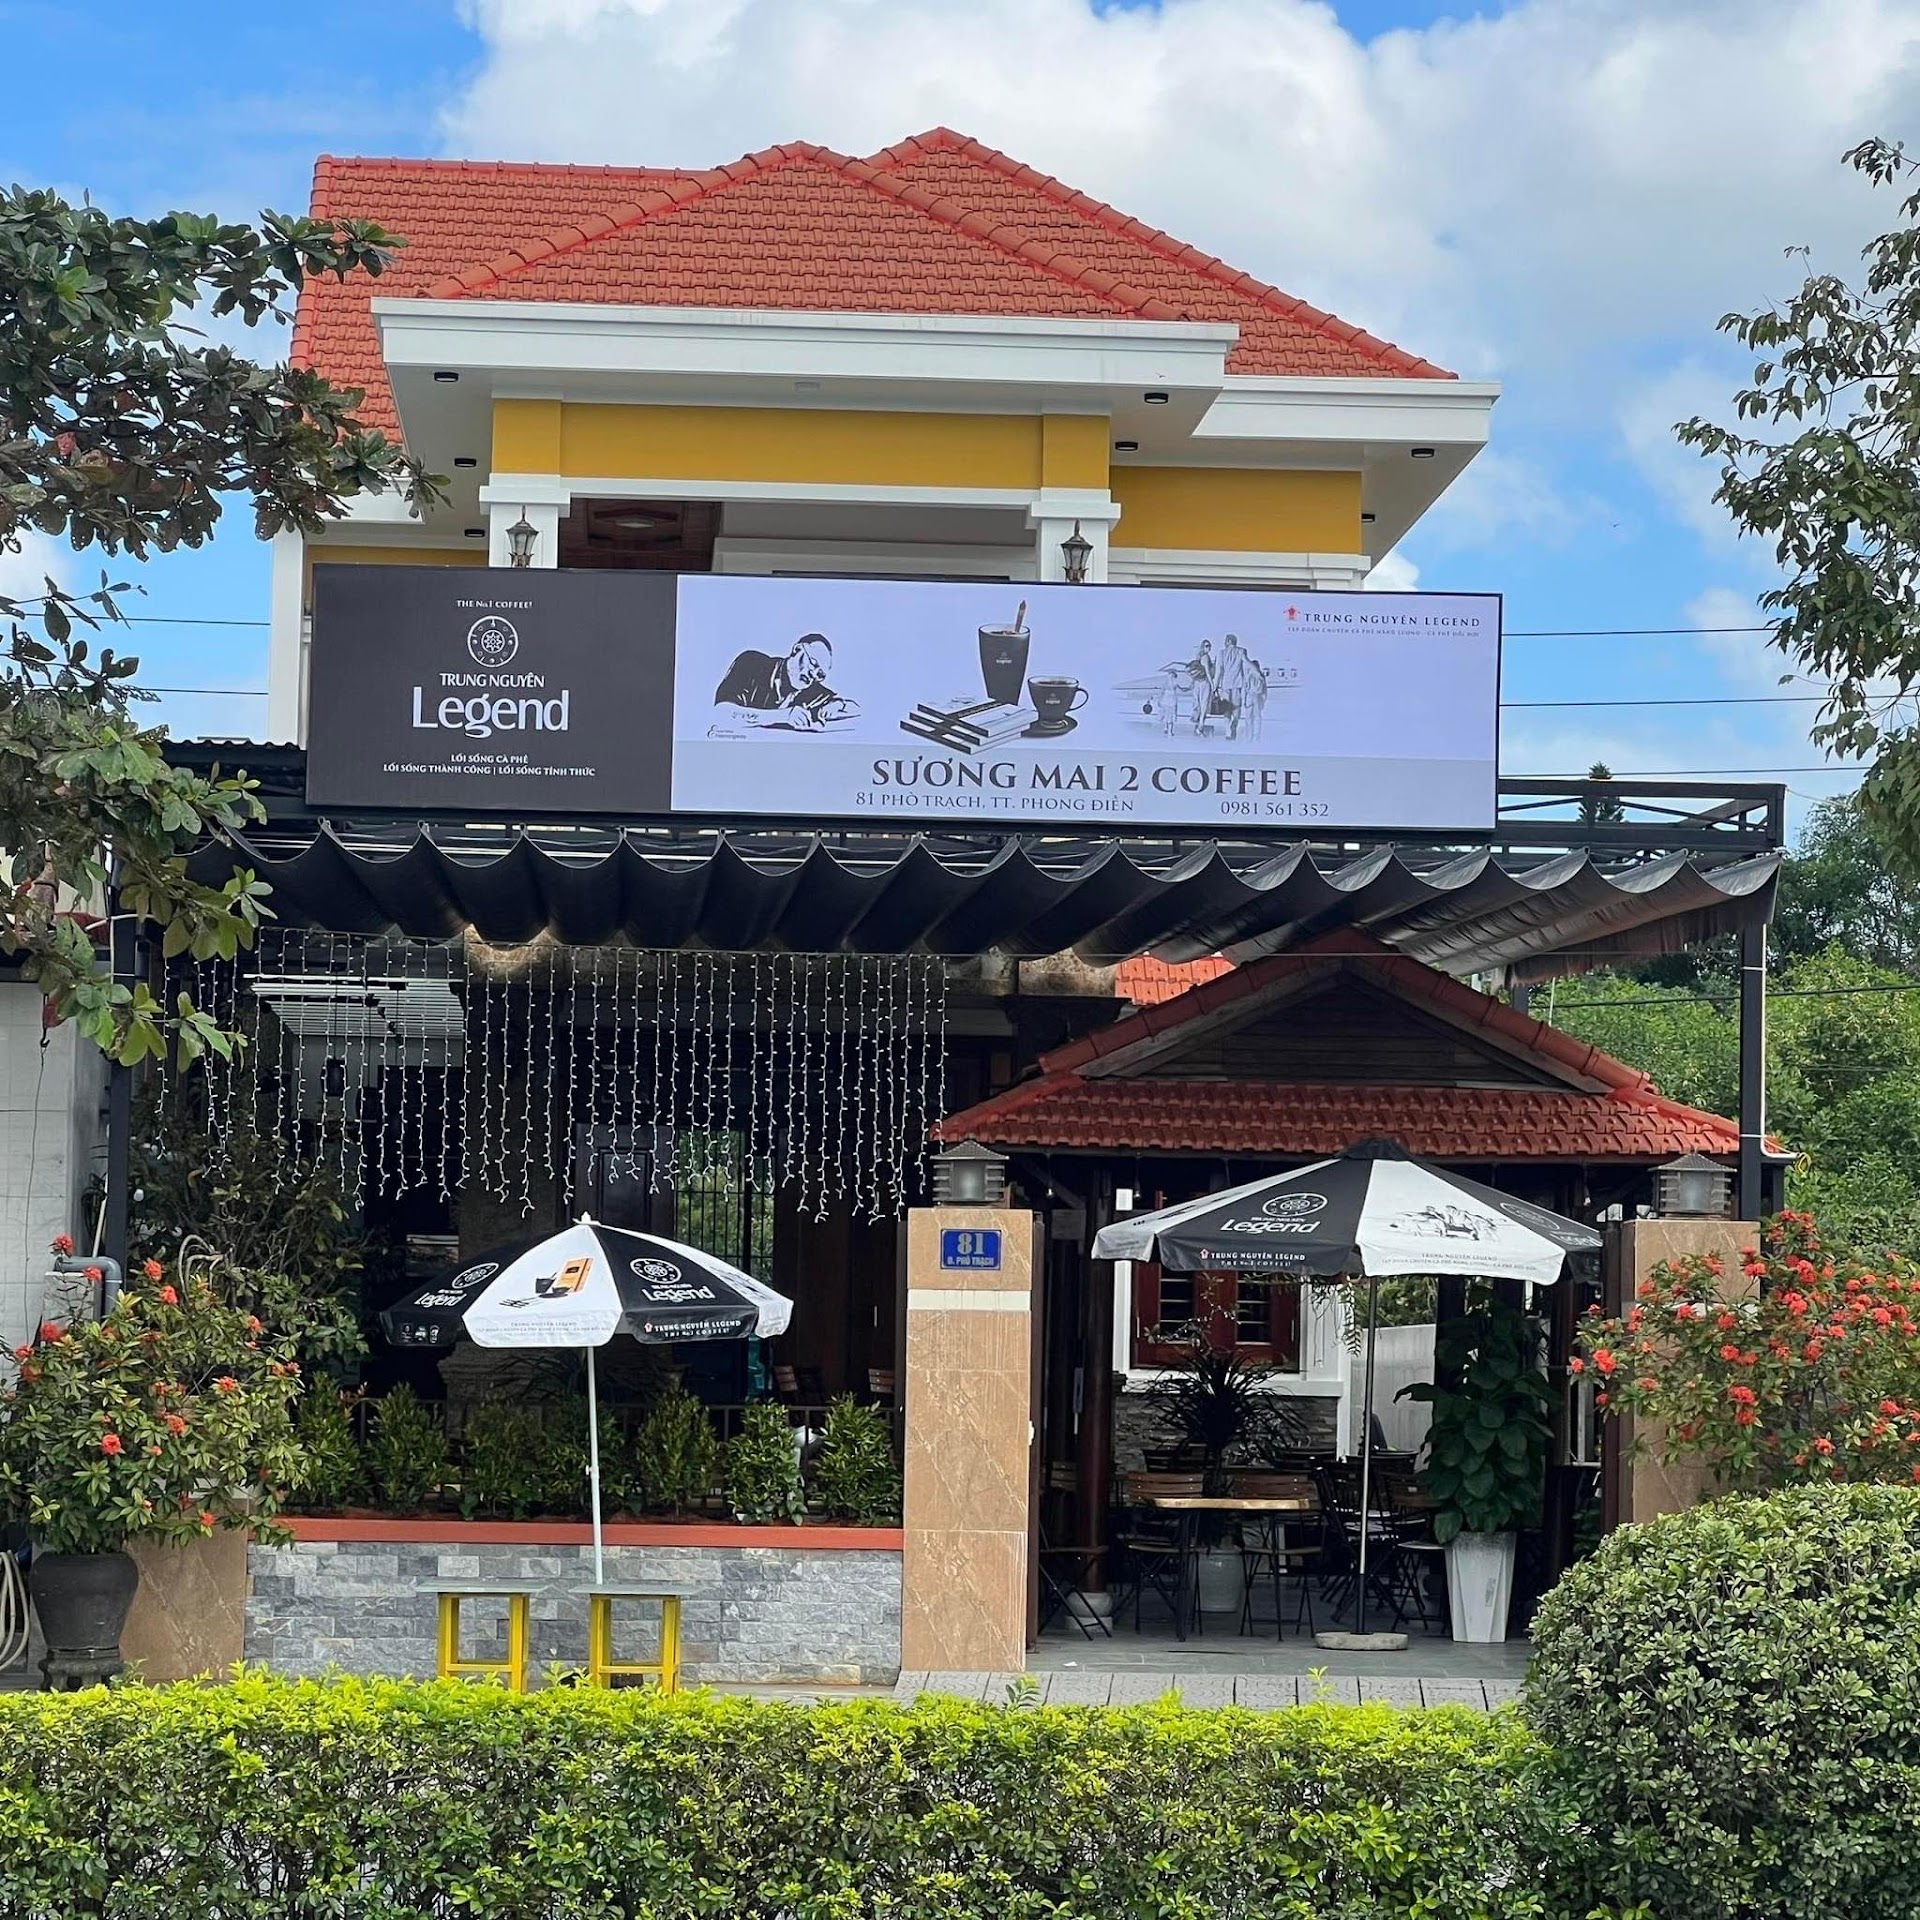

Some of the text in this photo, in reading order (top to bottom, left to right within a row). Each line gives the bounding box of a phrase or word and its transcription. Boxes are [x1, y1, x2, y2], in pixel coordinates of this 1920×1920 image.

[456, 600, 474, 608] THE
[1304, 613, 1353, 623] TRUNG
[1424, 616, 1480, 627] LEGEND
[439, 671, 545, 688] TRUNG NGUYÊN
[412, 686, 570, 739] Legend
[495, 754, 509, 764] CÀ
[428, 763, 462, 774] THÀNH
[463, 765, 491, 774] CÔNG
[871, 756, 1302, 796] SƯƠNG MAI 2 COFFEE
[856, 792, 874, 806] 81
[990, 797, 1016, 809] TT.
[1021, 798, 1085, 811] PHONG
[1220, 801, 1329, 817] 0981 561 352
[1220, 1219, 1321, 1234] Legend
[957, 1232, 984, 1255] 81
[1275, 1253, 1306, 1261] LEGEND
[642, 1285, 716, 1303] Legend
